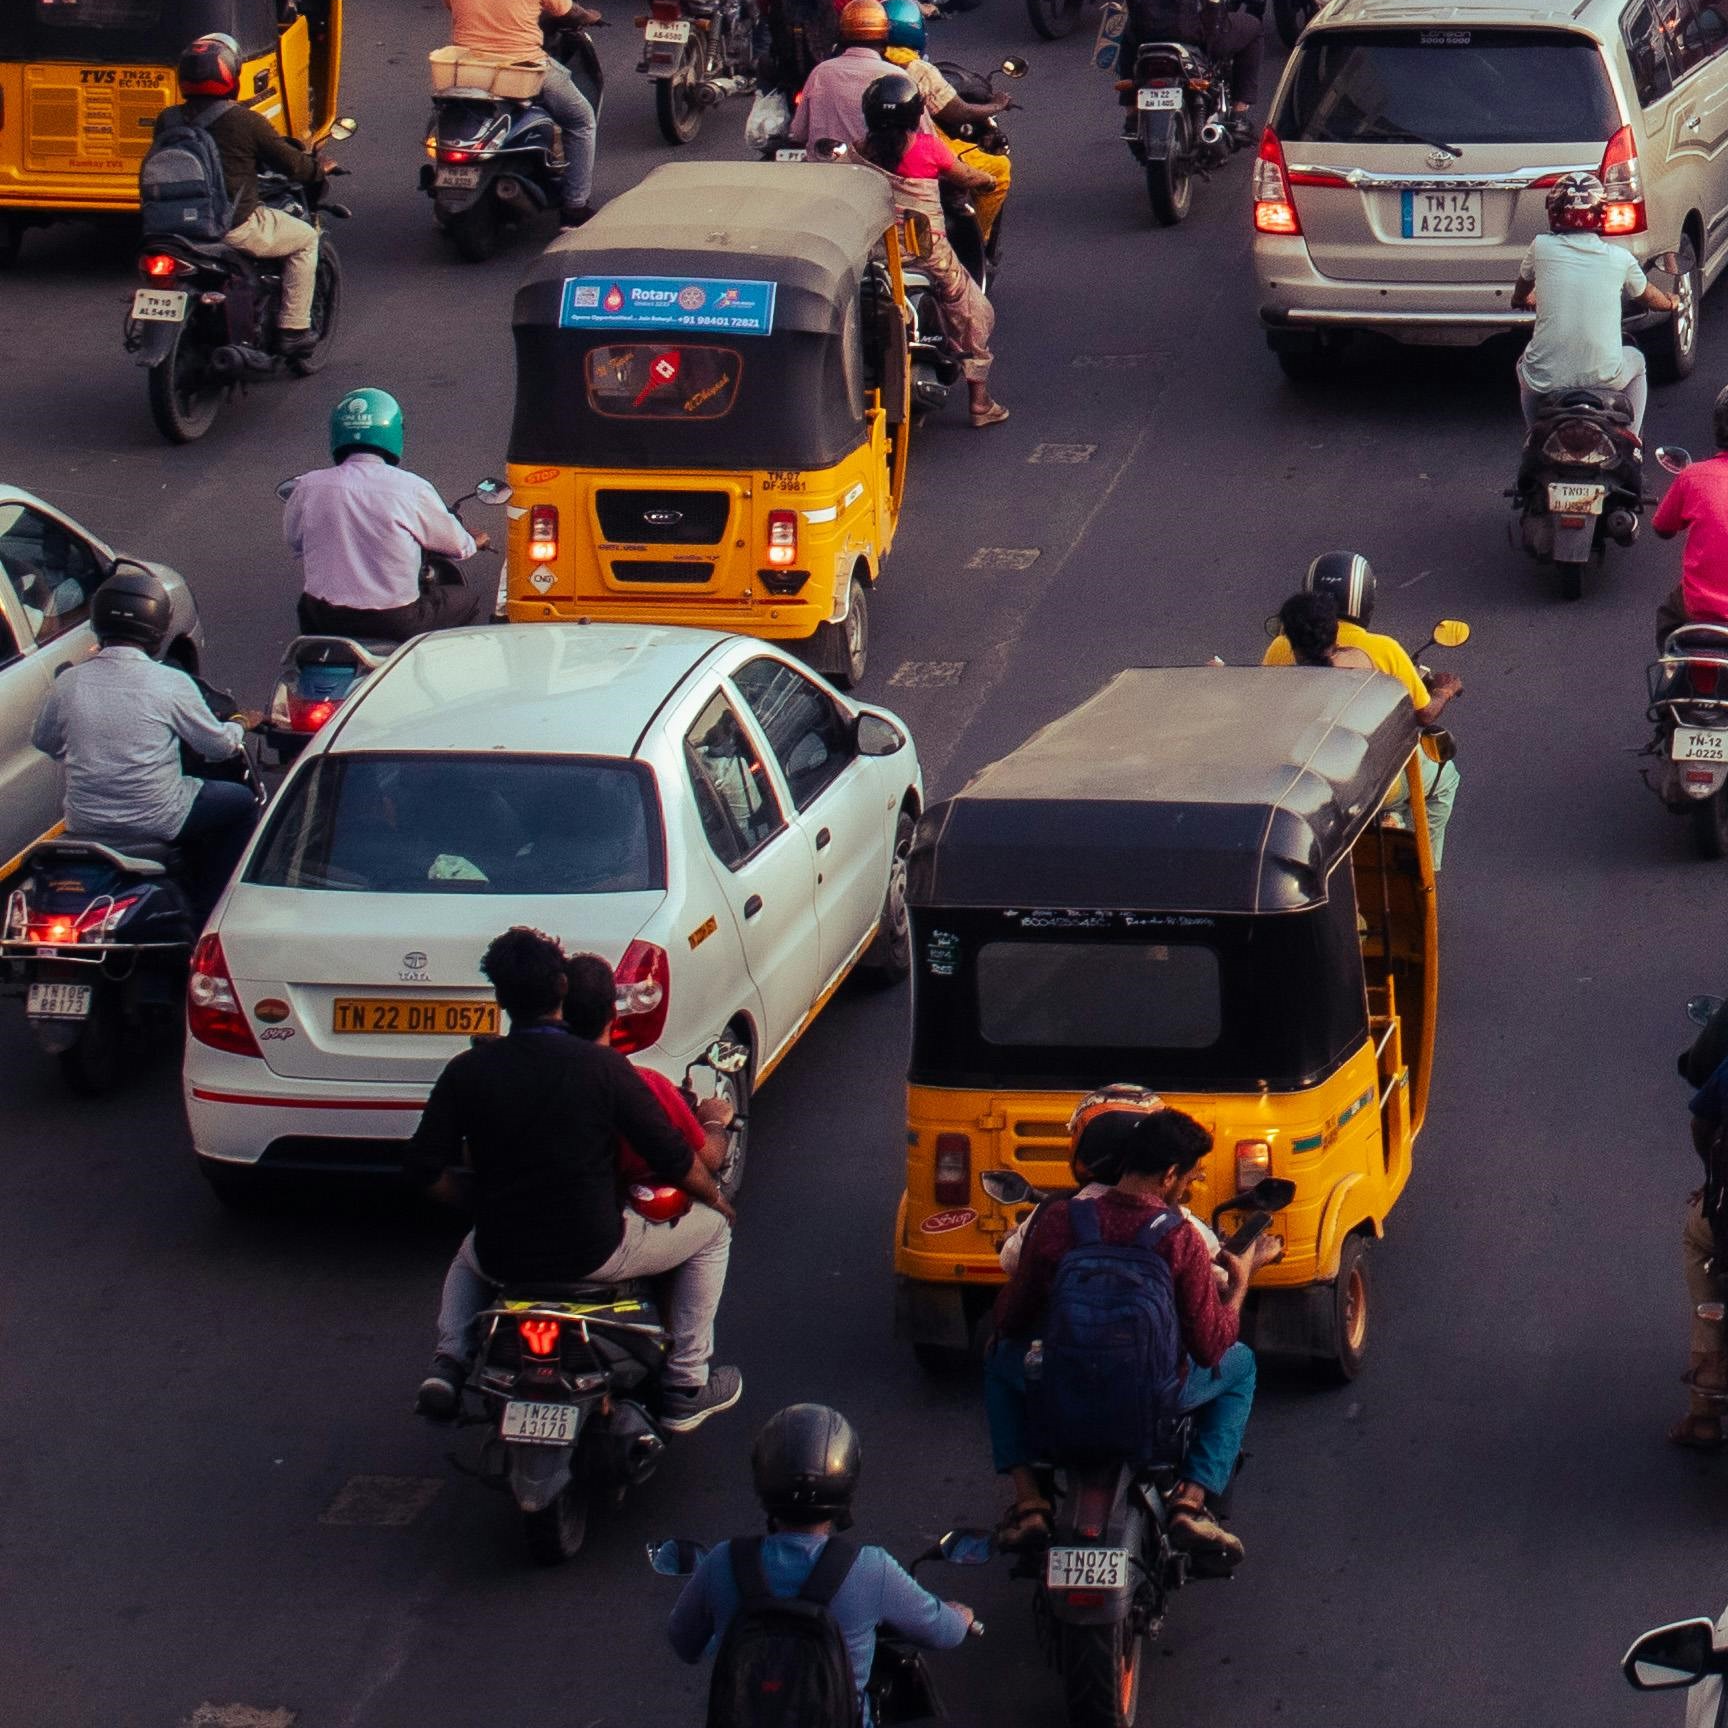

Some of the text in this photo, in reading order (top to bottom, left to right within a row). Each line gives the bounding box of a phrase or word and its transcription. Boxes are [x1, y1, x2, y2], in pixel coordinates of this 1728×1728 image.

[80, 69, 118, 84] TVS
[1426, 198, 1471, 213] TN 14
[1420, 215, 1478, 233] A 2233
[630, 287, 677, 303] Rotary
[1688, 736, 1723, 748] TN-12
[1685, 748, 1724, 760] J-0225
[339, 1003, 500, 1032] TN 22 DH 0571
[928, 1212, 974, 1231] Stop
[519, 1420, 568, 1438] A3170
[1064, 1551, 1118, 1570] TN07C
[1063, 1570, 1118, 1588] T7643
